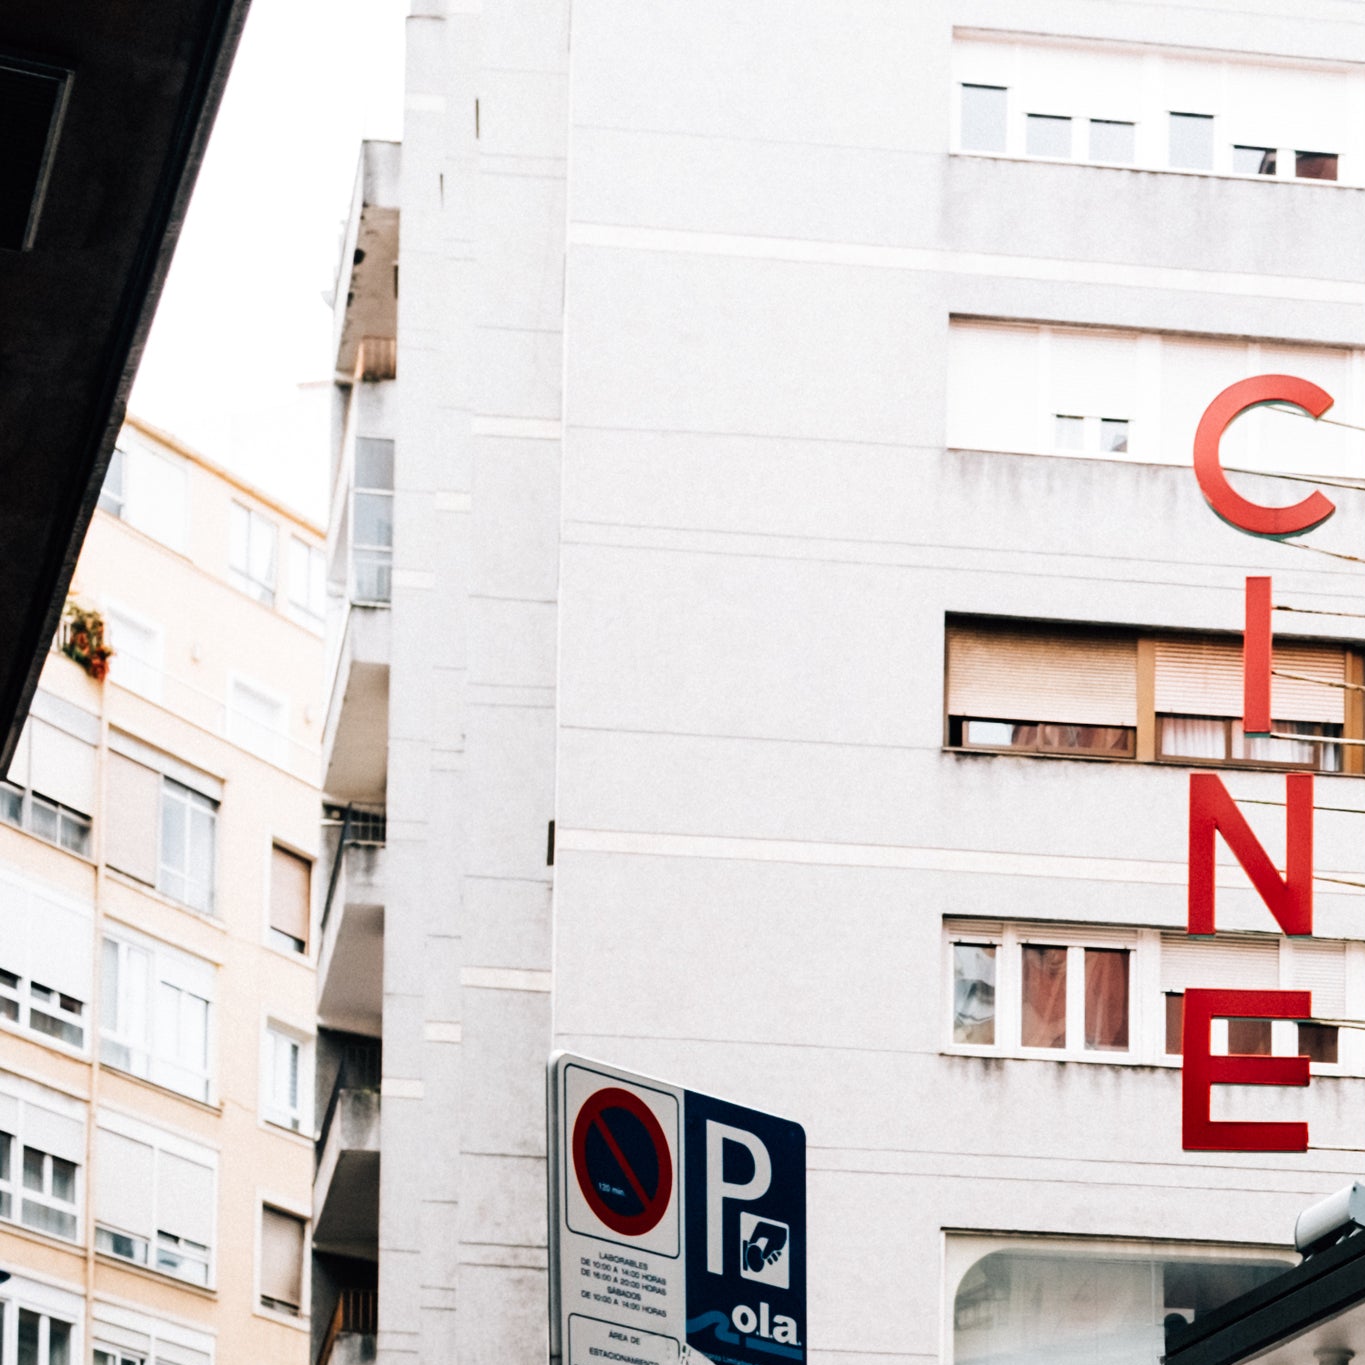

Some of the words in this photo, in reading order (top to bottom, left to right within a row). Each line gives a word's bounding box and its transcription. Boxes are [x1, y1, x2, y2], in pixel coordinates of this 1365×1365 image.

[1182, 374, 1335, 1152] CINE
[706, 1119, 772, 1275] P
[580, 1257, 590, 1266] DE
[642, 1273, 666, 1285] HORAS
[599, 1251, 648, 1271] LABORABLES
[580, 1268, 590, 1276] DE
[642, 1284, 667, 1296] HORAS
[581, 1290, 591, 1299] DE
[642, 1306, 667, 1318] HORAS
[630, 1336, 640, 1345] DE
